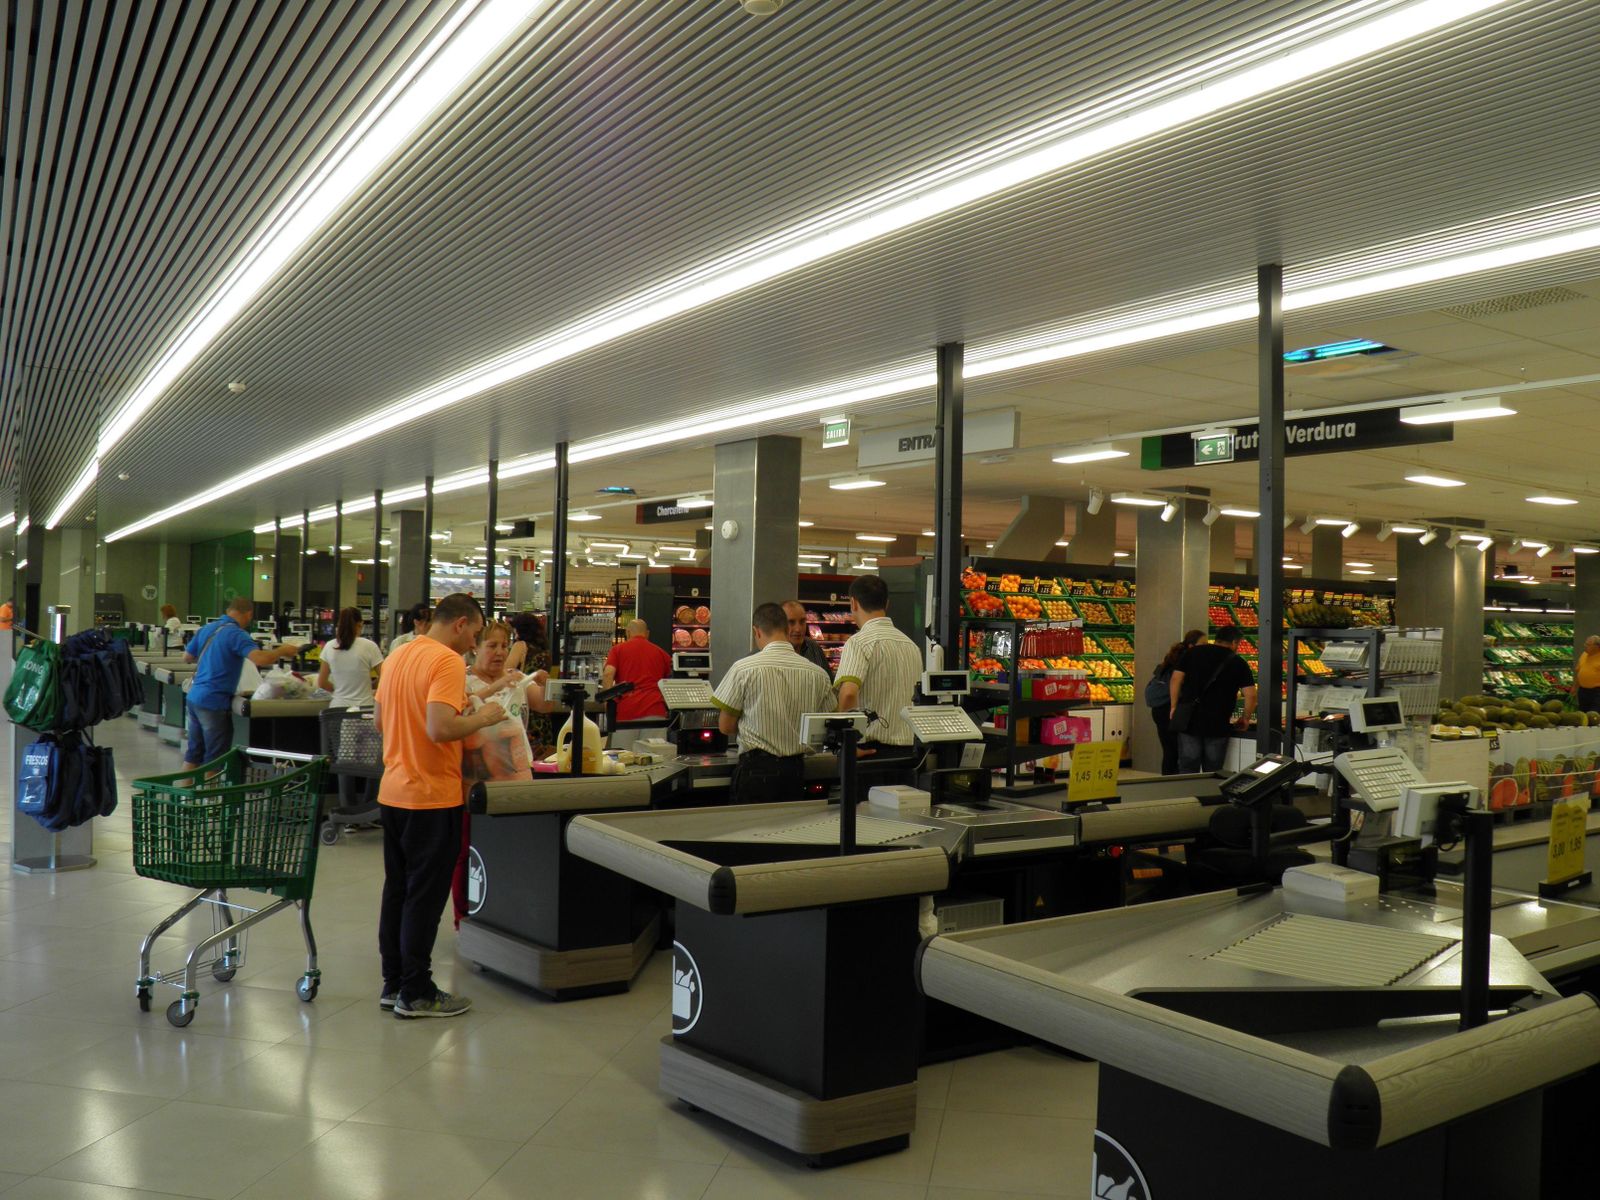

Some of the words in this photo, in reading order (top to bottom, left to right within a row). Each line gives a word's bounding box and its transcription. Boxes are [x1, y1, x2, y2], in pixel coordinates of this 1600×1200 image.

[826, 429, 846, 440] SALIDA
[898, 433, 937, 452] ENTRA
[1235, 431, 1259, 450] rut
[1285, 421, 1357, 444] Verdura
[25, 755, 49, 766] FRESCOS
[1075, 770, 1091, 784] 1,45
[1097, 768, 1113, 782] 1,45
